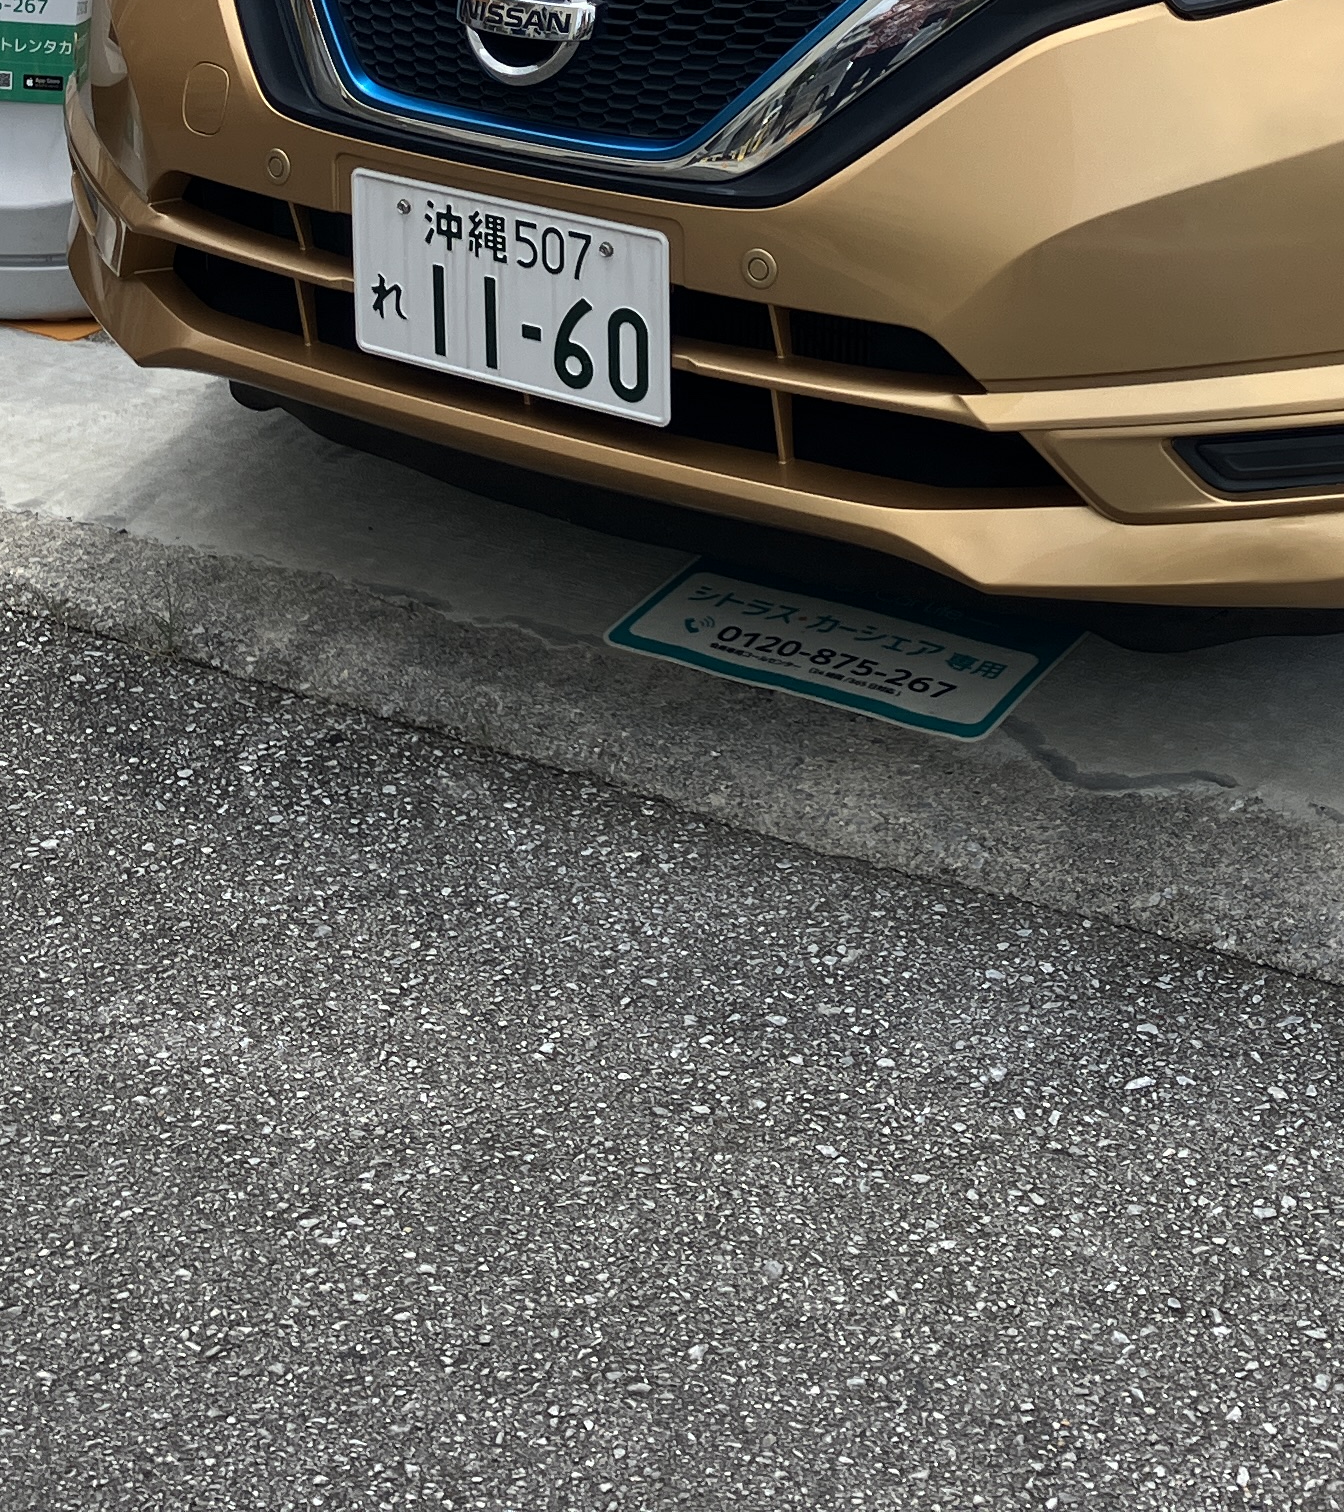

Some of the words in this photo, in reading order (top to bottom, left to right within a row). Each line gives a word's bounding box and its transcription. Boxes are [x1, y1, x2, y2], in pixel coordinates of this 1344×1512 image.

[460, 0, 572, 34] NISSAN
[371, 273, 408, 320] れ
[432, 264, 649, 403] 11-60
[687, 585, 944, 658] シトラス・カーシェア
[945, 651, 1009, 680] 専用
[716, 625, 959, 698] 0120-875-267
